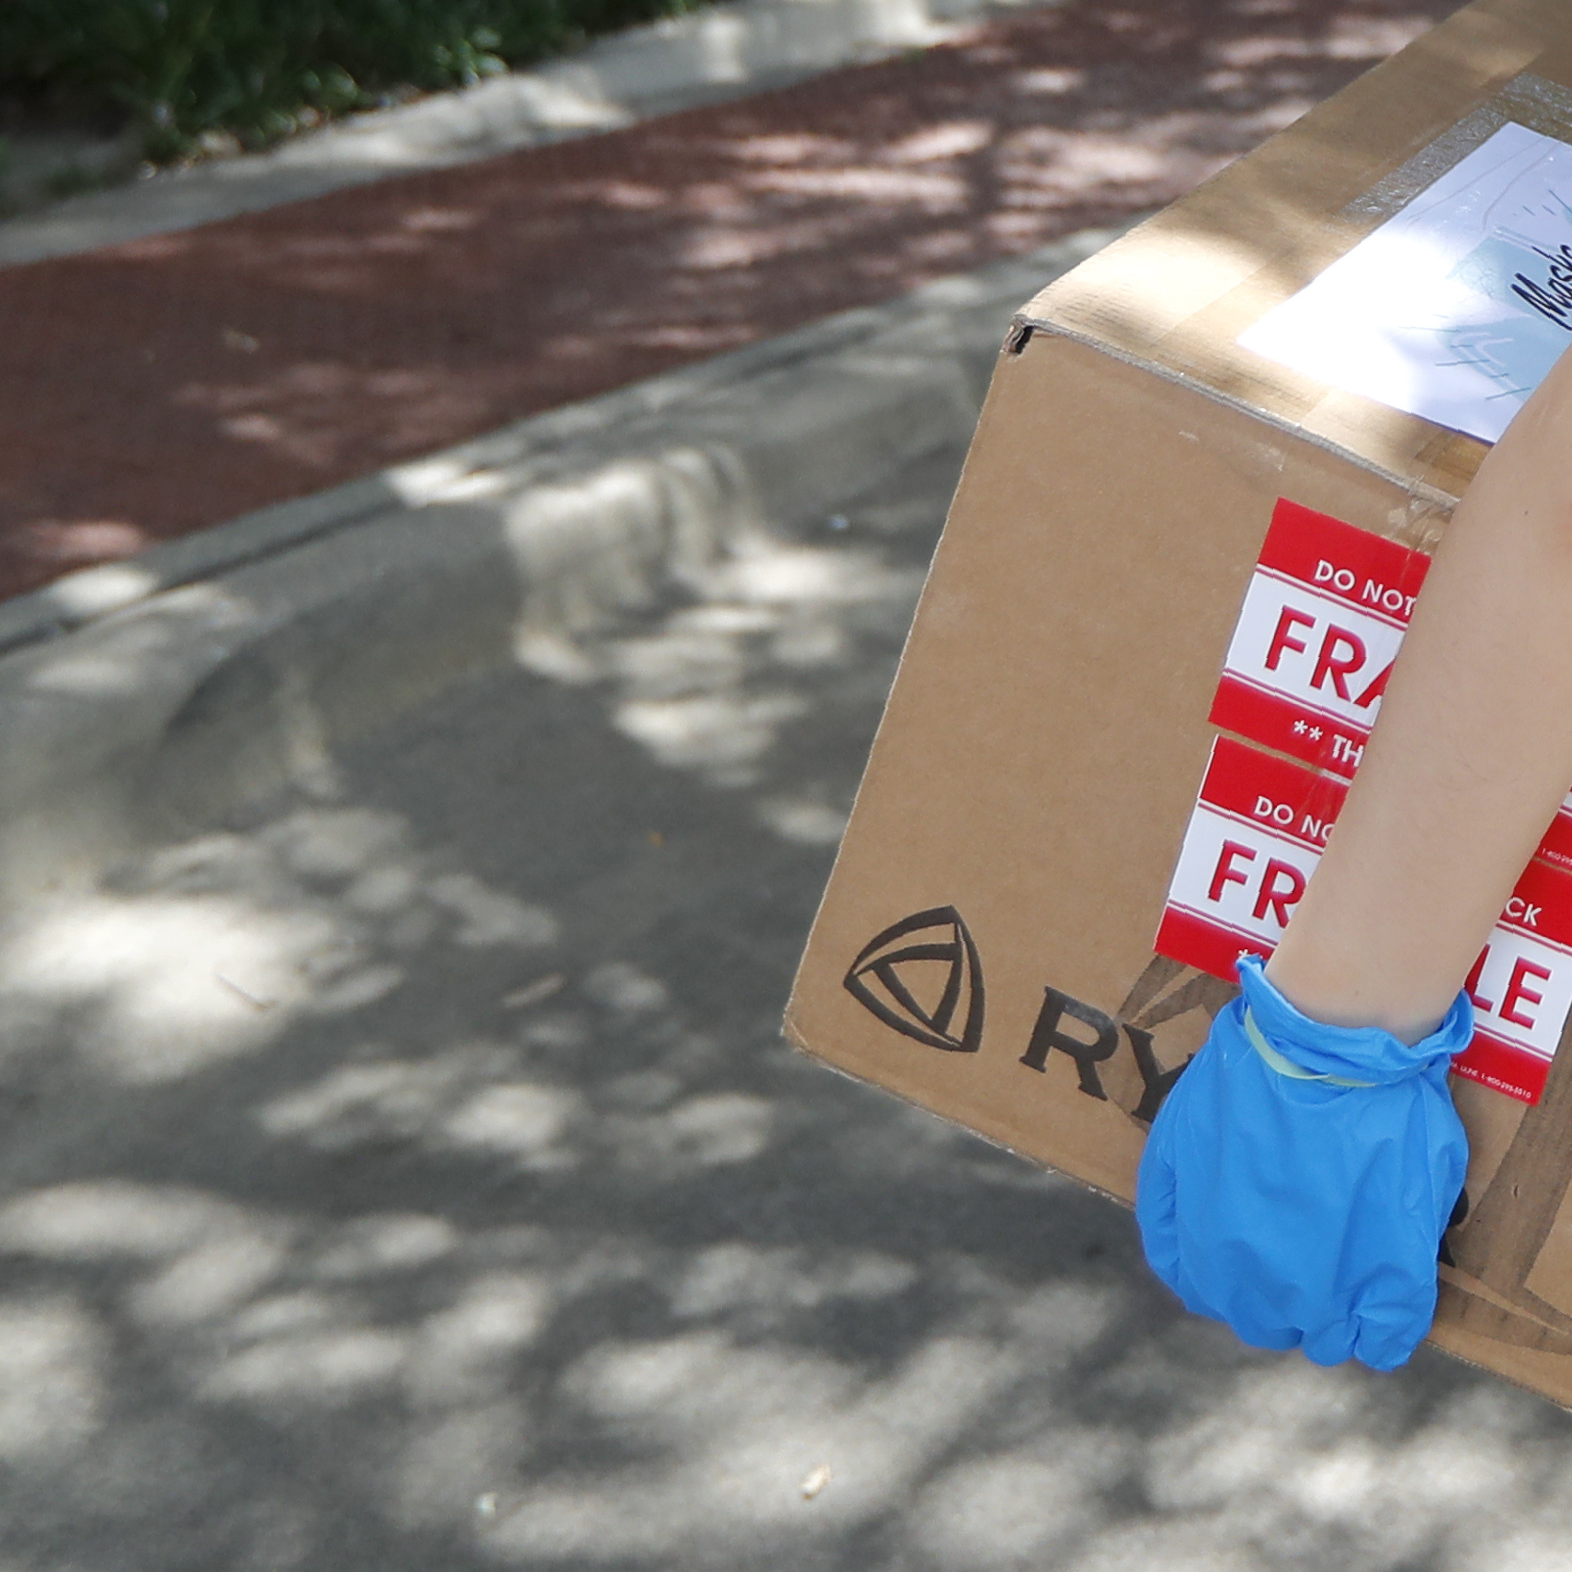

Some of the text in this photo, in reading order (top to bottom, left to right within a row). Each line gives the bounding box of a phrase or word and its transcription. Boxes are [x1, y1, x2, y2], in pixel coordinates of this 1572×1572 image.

[1314, 559, 1417, 617] DO NOT
[1254, 795, 1295, 825] DO
